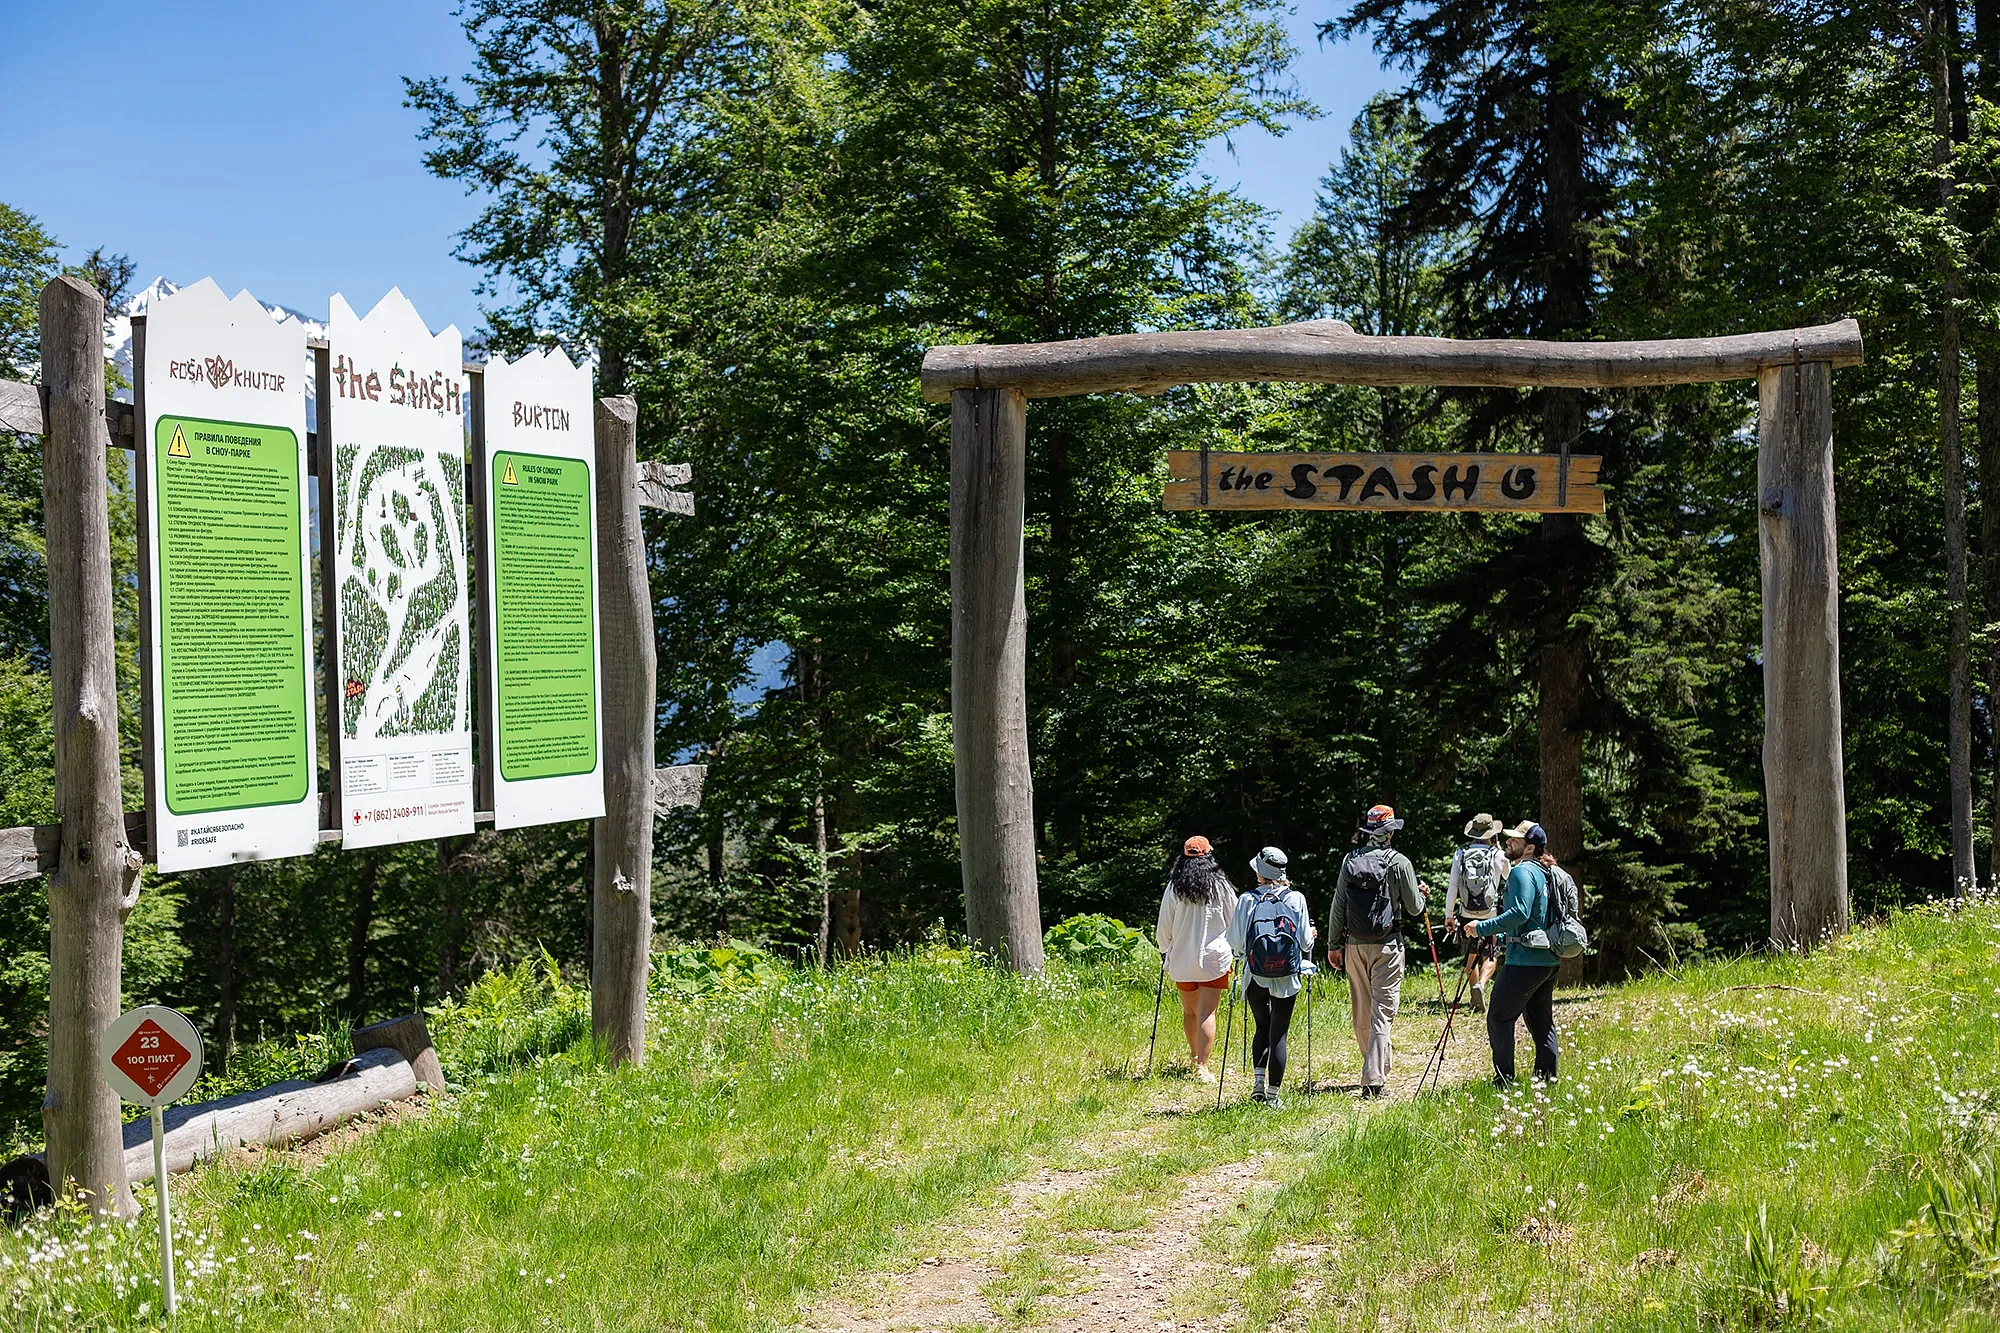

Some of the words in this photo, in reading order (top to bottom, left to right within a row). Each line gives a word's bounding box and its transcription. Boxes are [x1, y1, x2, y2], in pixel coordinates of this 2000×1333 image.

[234, 368, 285, 393] KHUTOR
[333, 355, 382, 402] the
[512, 401, 569, 432] BURTON
[194, 432, 224, 443] ПРАВИЛА
[225, 435, 262, 447] ПОВЕДЕНИЯ
[212, 447, 251, 458] СНОУ-ПАРКЕ
[1219, 466, 1273, 491] the
[1283, 463, 1480, 502] STASH
[364, 812, 372, 821] +7
[374, 808, 392, 822] (862)
[393, 806, 423, 818] 2408-911
[140, 1036, 160, 1049] 23
[126, 1056, 145, 1064] 100
[147, 1054, 175, 1064] ПИХТ
